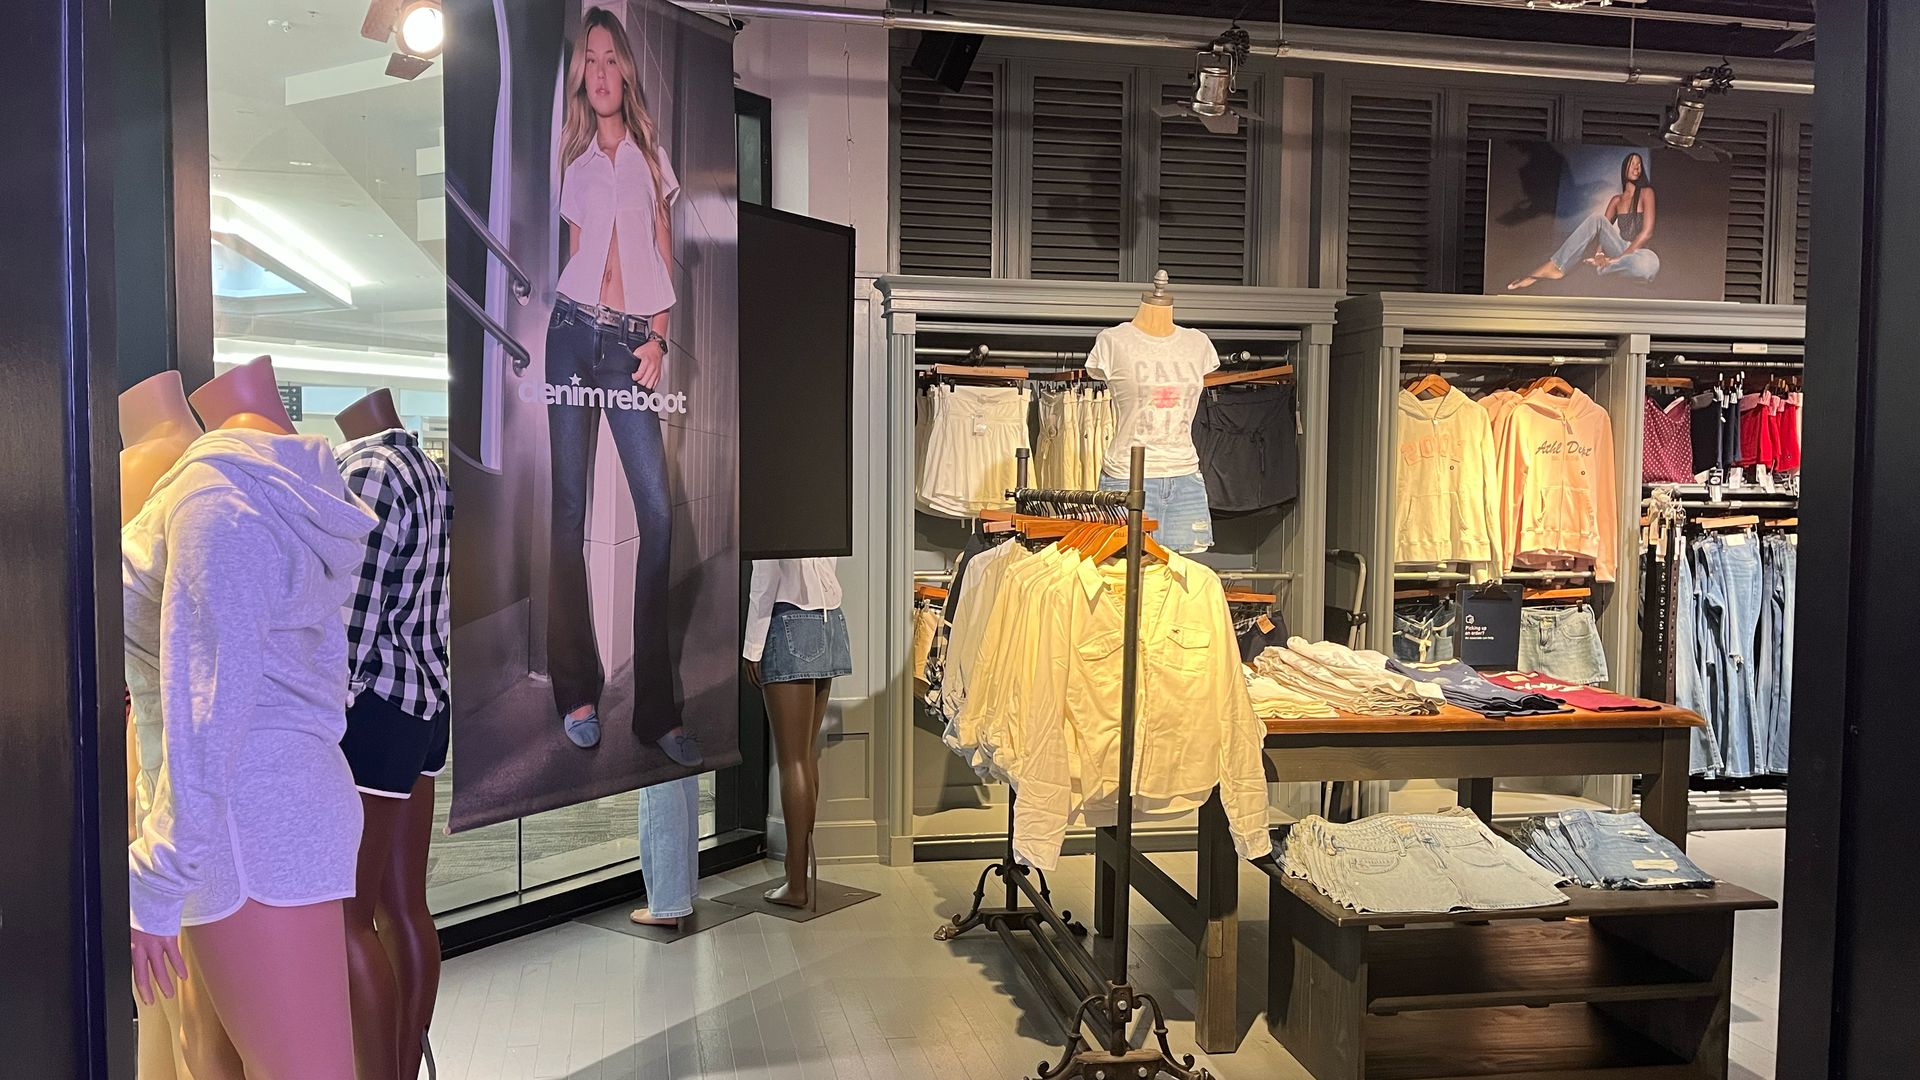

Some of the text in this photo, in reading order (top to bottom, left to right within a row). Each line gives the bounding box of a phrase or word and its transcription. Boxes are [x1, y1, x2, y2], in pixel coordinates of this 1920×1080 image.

[1135, 361, 1199, 383] CALI
[518, 375, 687, 414] denim reboot
